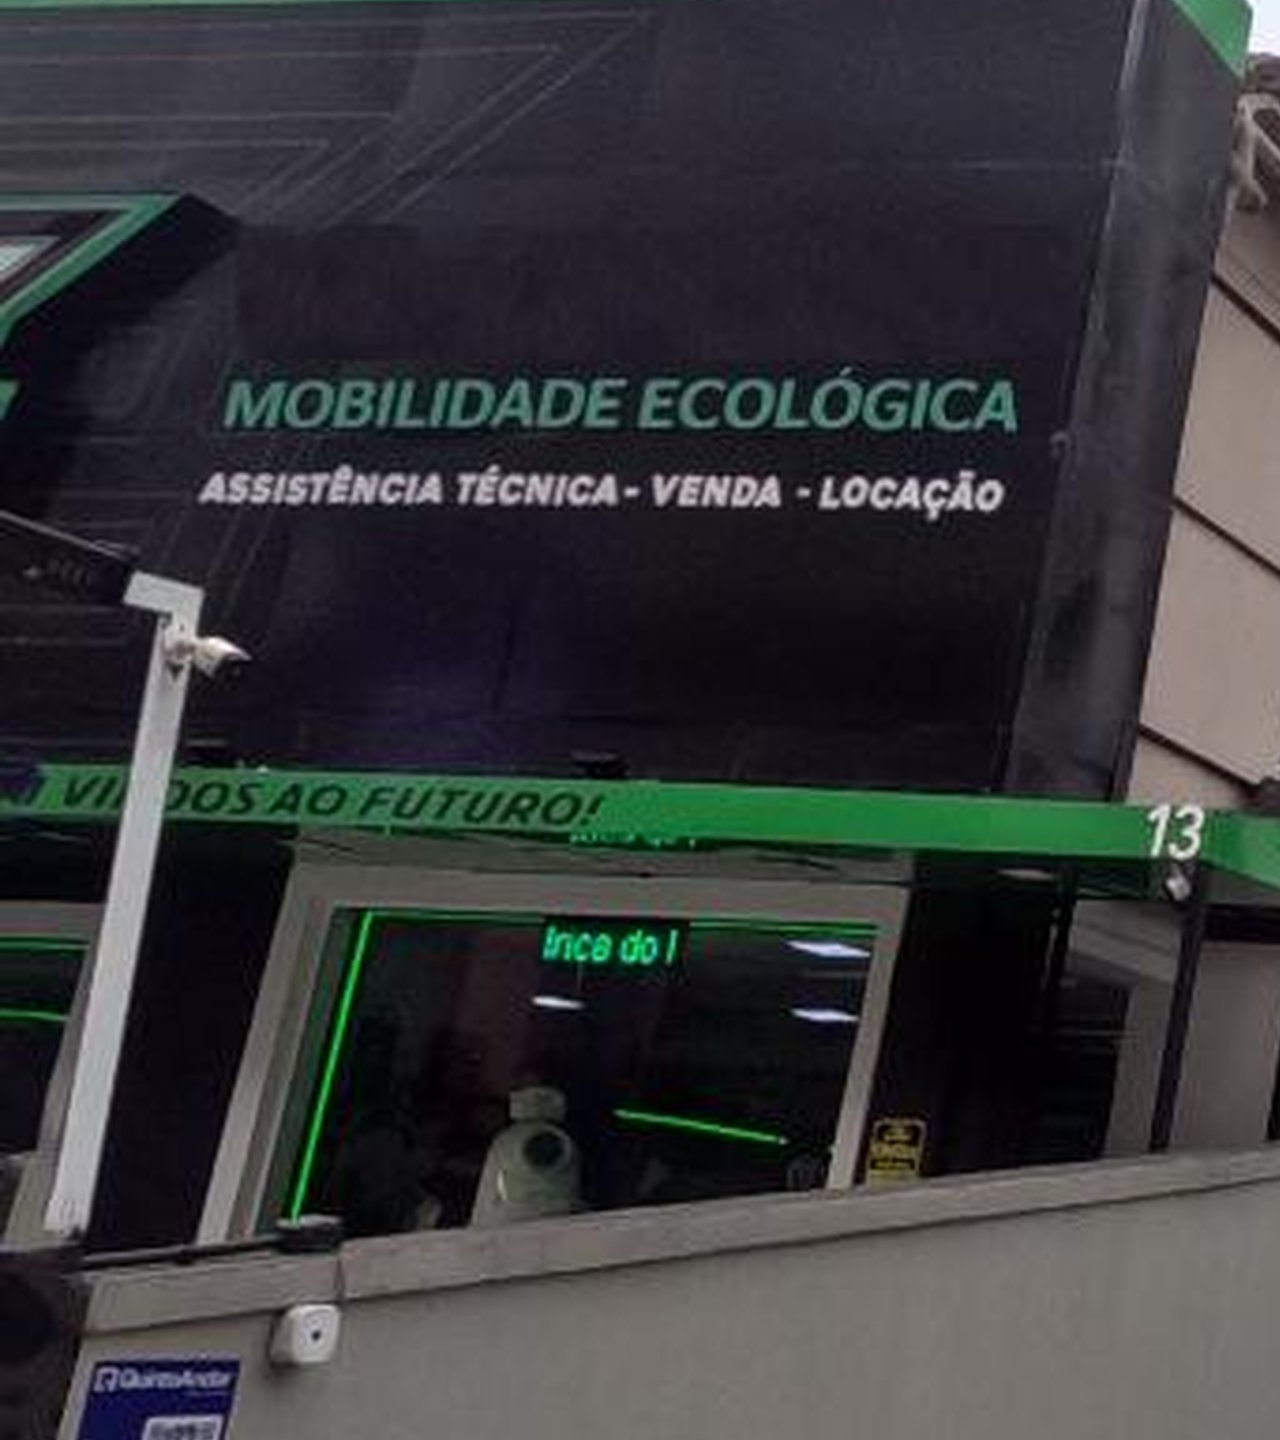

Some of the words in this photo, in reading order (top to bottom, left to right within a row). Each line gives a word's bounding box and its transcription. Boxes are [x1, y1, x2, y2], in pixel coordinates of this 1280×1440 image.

[223, 378, 628, 429] MOBILIDADE
[637, 366, 1018, 432] ECOLÓGICA
[198, 464, 443, 506] ASSISTÊNCIA
[456, 464, 619, 506] TÉCNICA
[652, 473, 782, 508] VENDA
[818, 469, 1005, 522] LOCAÇÃO
[62, 776, 263, 816] VIDOS
[269, 782, 348, 818] AO
[358, 785, 606, 826] FUTURO!
[1145, 803, 1205, 860] 13
